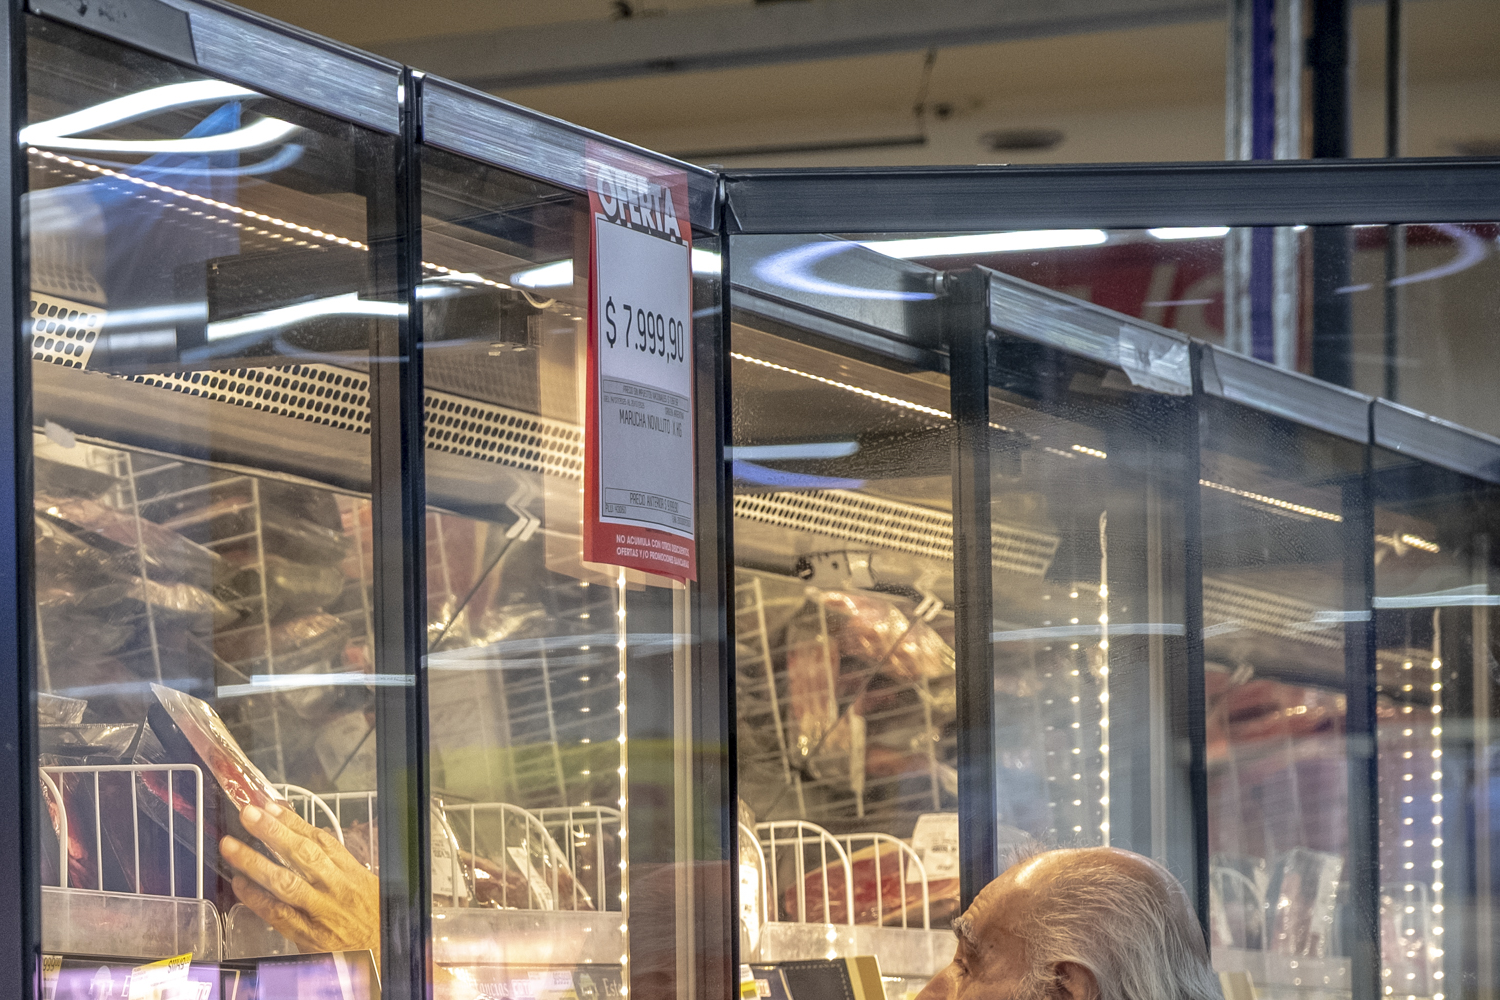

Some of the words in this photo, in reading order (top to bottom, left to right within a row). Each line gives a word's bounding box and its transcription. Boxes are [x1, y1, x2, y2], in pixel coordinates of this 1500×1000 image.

[597, 168, 682, 238] OFERTA
[605, 296, 617, 349] $
[622, 303, 684, 364] 7.999,90
[619, 409, 647, 429] MARUCHA
[616, 534, 626, 544] NO
[626, 535, 651, 547] ACUMULA
[651, 538, 661, 549] CON
[616, 546, 638, 558] OFERTAS
